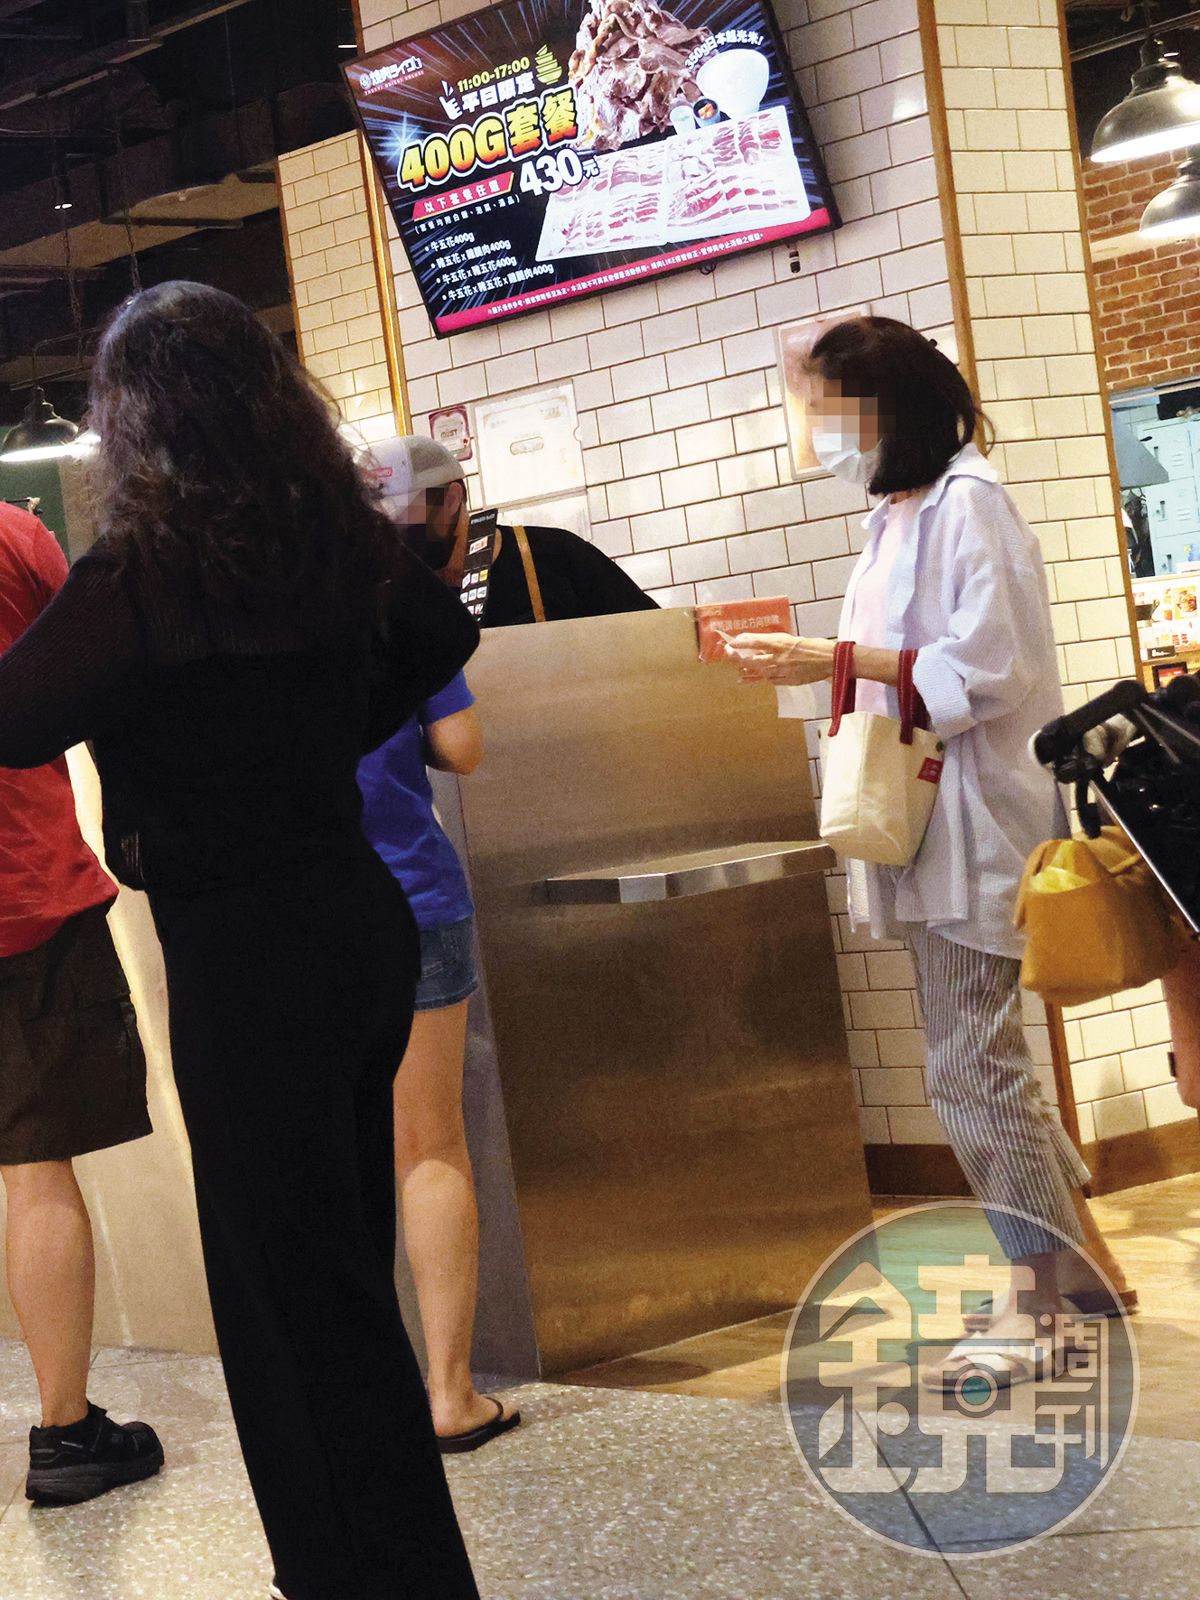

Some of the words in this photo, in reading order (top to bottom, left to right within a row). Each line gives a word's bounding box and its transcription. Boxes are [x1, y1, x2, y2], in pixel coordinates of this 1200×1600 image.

[457, 56, 531, 93] 11:00-17:00
[461, 71, 536, 113] 平日限定
[400, 87, 578, 191] 400G套餐
[430, 231, 476, 252] 牛五花400g
